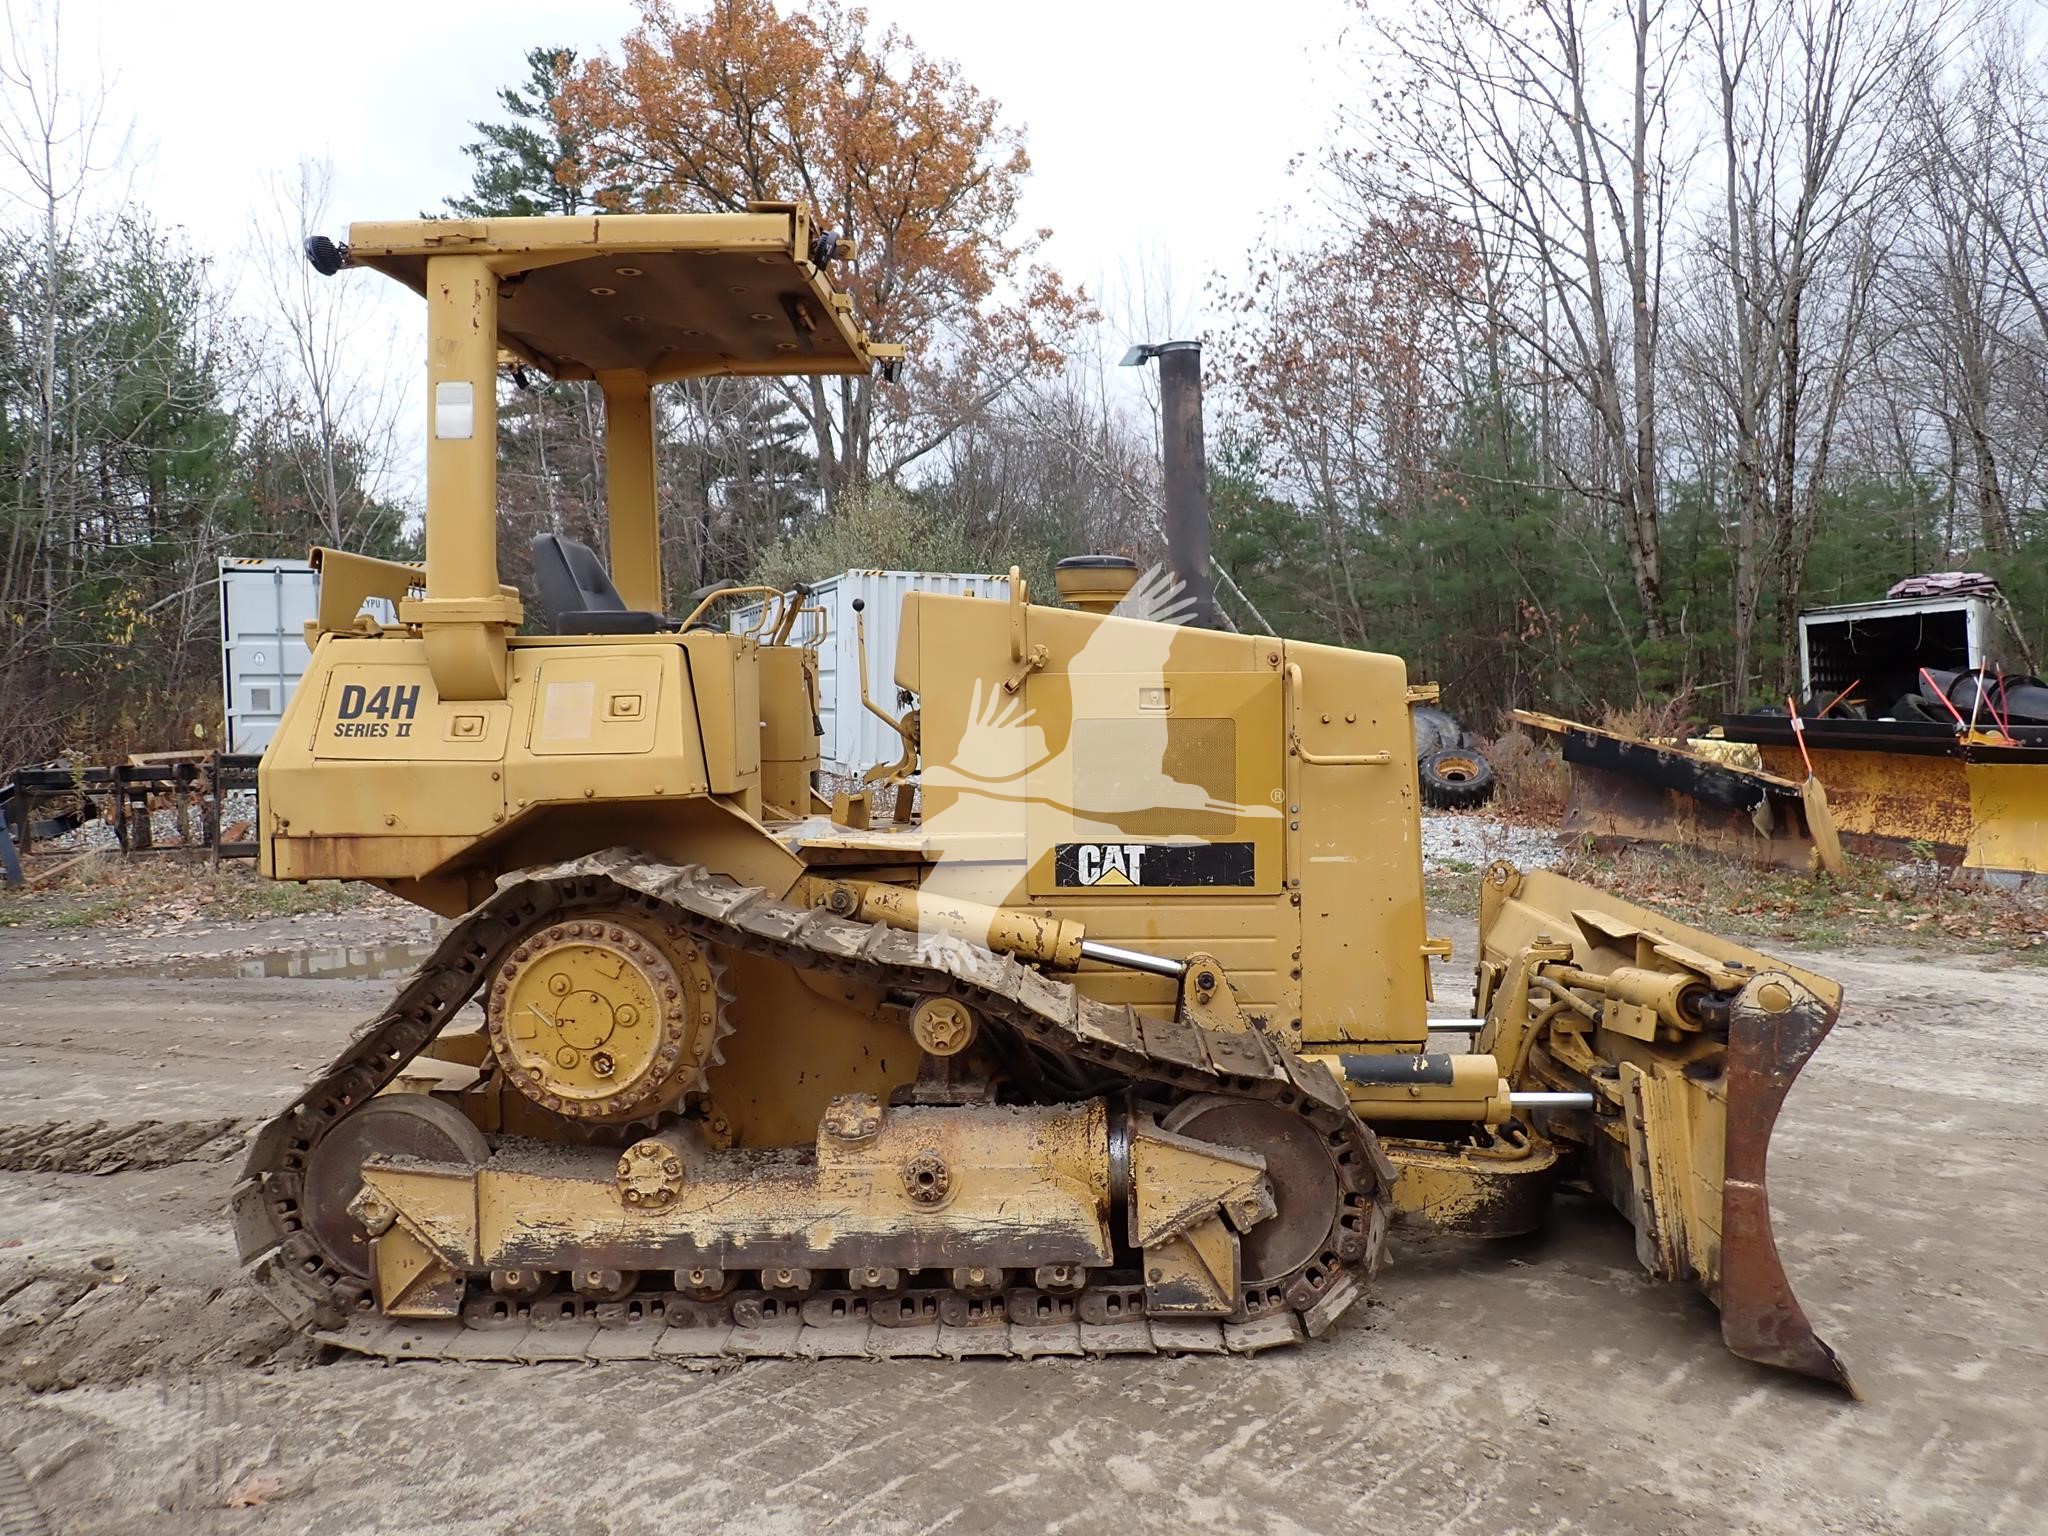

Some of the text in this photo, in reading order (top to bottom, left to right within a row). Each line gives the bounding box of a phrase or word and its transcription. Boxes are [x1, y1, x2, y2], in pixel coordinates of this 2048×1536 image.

[362, 599, 381, 608] YPU
[338, 685, 421, 719] D4H
[334, 723, 412, 737] SERIES II
[1078, 845, 1146, 886] CAT
